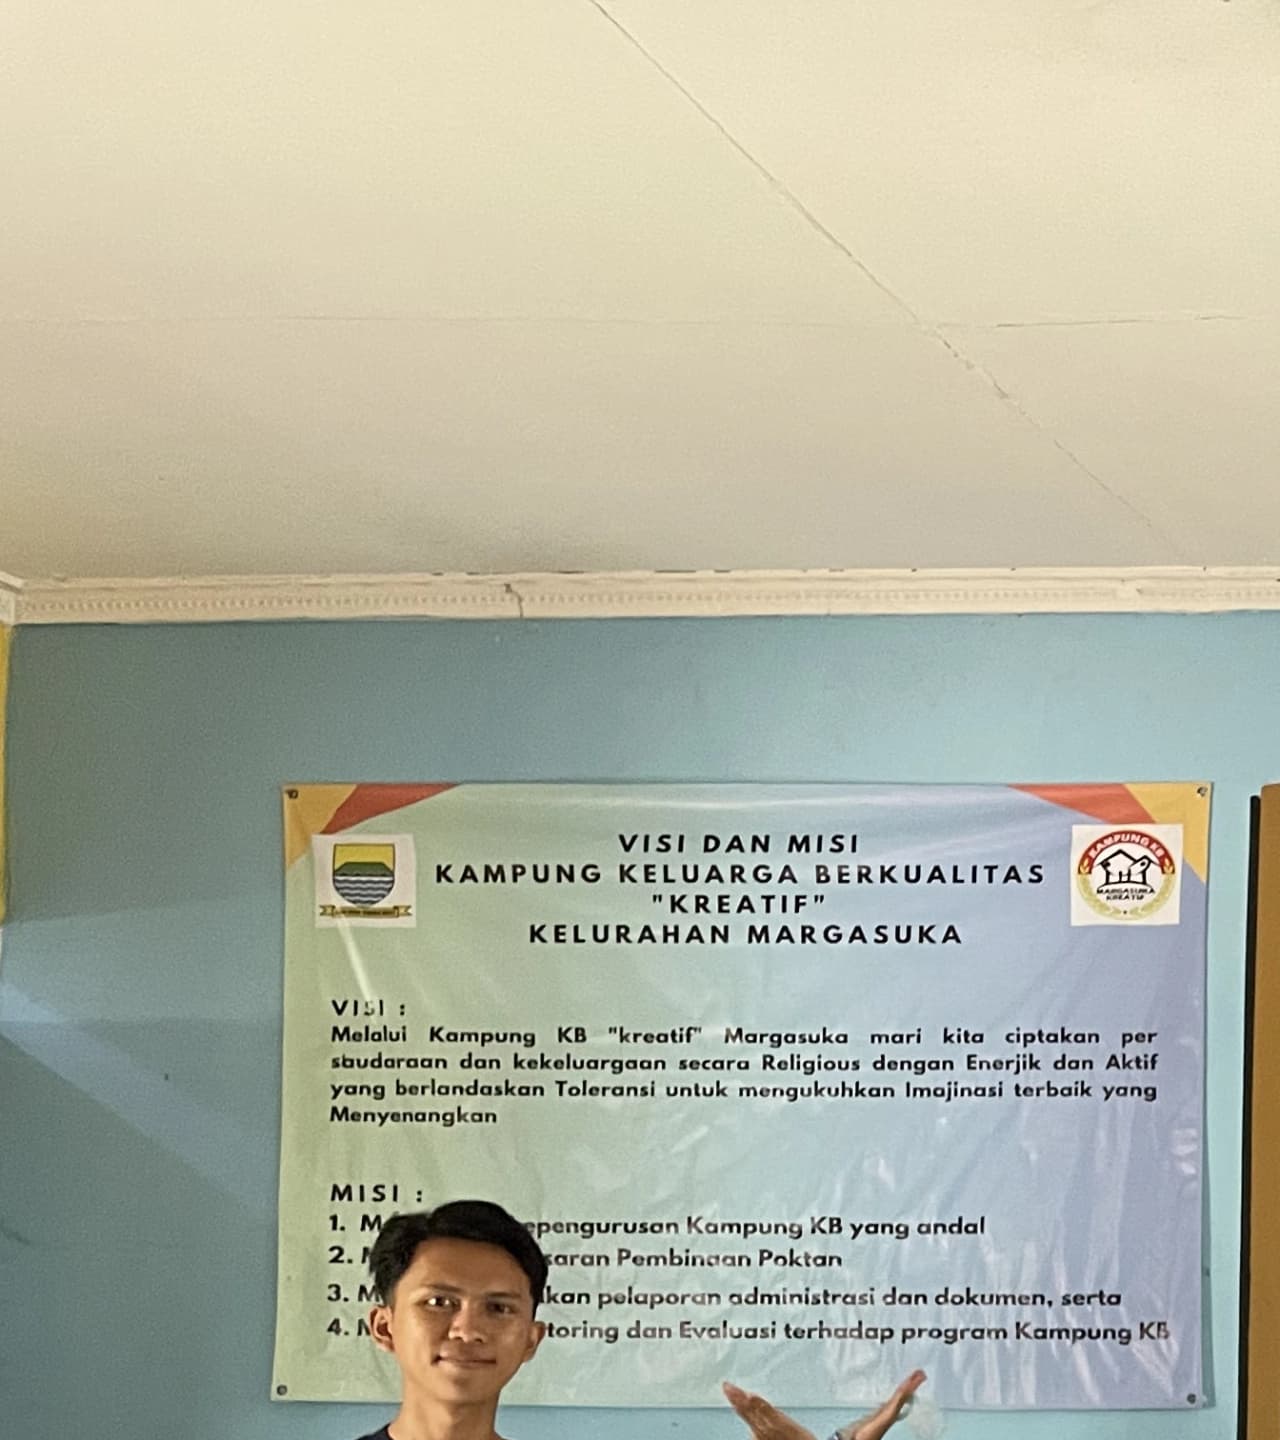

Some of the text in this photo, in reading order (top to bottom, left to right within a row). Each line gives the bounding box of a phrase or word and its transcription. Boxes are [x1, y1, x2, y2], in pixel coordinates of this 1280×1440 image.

[618, 834, 857, 854] VISI DAN MISI
[1088, 833, 1149, 859] KAMPUNG
[436, 863, 1044, 885] KAMPUNG KELUARGA BERKUALITAS
[652, 894, 825, 914] "KREATIF"
[529, 924, 962, 945] KELURAHAN MARGASUKA
[331, 1024, 1158, 1049] Melalui Kampung KB "kreatif" Margasuka mari kita ciptakan per
[459, 1051, 501, 1070] dan
[513, 1052, 667, 1075] kekeluargaan
[678, 1059, 750, 1071] secara
[761, 1052, 861, 1076] Religious
[871, 1053, 955, 1076] dengan
[966, 1052, 1042, 1076] Enerjik
[1052, 1053, 1094, 1071] dan
[1105, 1052, 1159, 1071] Aktif
[330, 1077, 1157, 1103] yang berlandaskan Toleransi untuk mengukuhkan Imajinasi terbaik yang
[330, 1105, 497, 1128] Menyenangkan
[330, 1183, 398, 1203] MISI
[328, 1213, 346, 1232] 1.
[526, 1219, 680, 1241] epengurusan
[687, 1215, 803, 1241] Kampung
[810, 1216, 843, 1235] KB
[849, 1222, 910, 1241] yang
[916, 1215, 985, 1235] andal
[328, 1245, 354, 1264] 2.
[617, 1247, 752, 1268] Pembinaan
[758, 1247, 843, 1268] Poktan
[327, 1283, 349, 1302] 3.
[597, 1285, 722, 1311] pelaporan
[728, 1285, 875, 1306] administrasi
[881, 1286, 928, 1306] dan
[934, 1286, 1053, 1308] dokumen,
[1061, 1289, 1122, 1307] serta
[327, 1317, 349, 1336] 4.
[626, 1319, 673, 1339] dan
[679, 1319, 777, 1340] Evaluasi
[783, 1319, 895, 1345] terhadap
[901, 1327, 1008, 1345] program
[1015, 1321, 1132, 1346] Kampung
